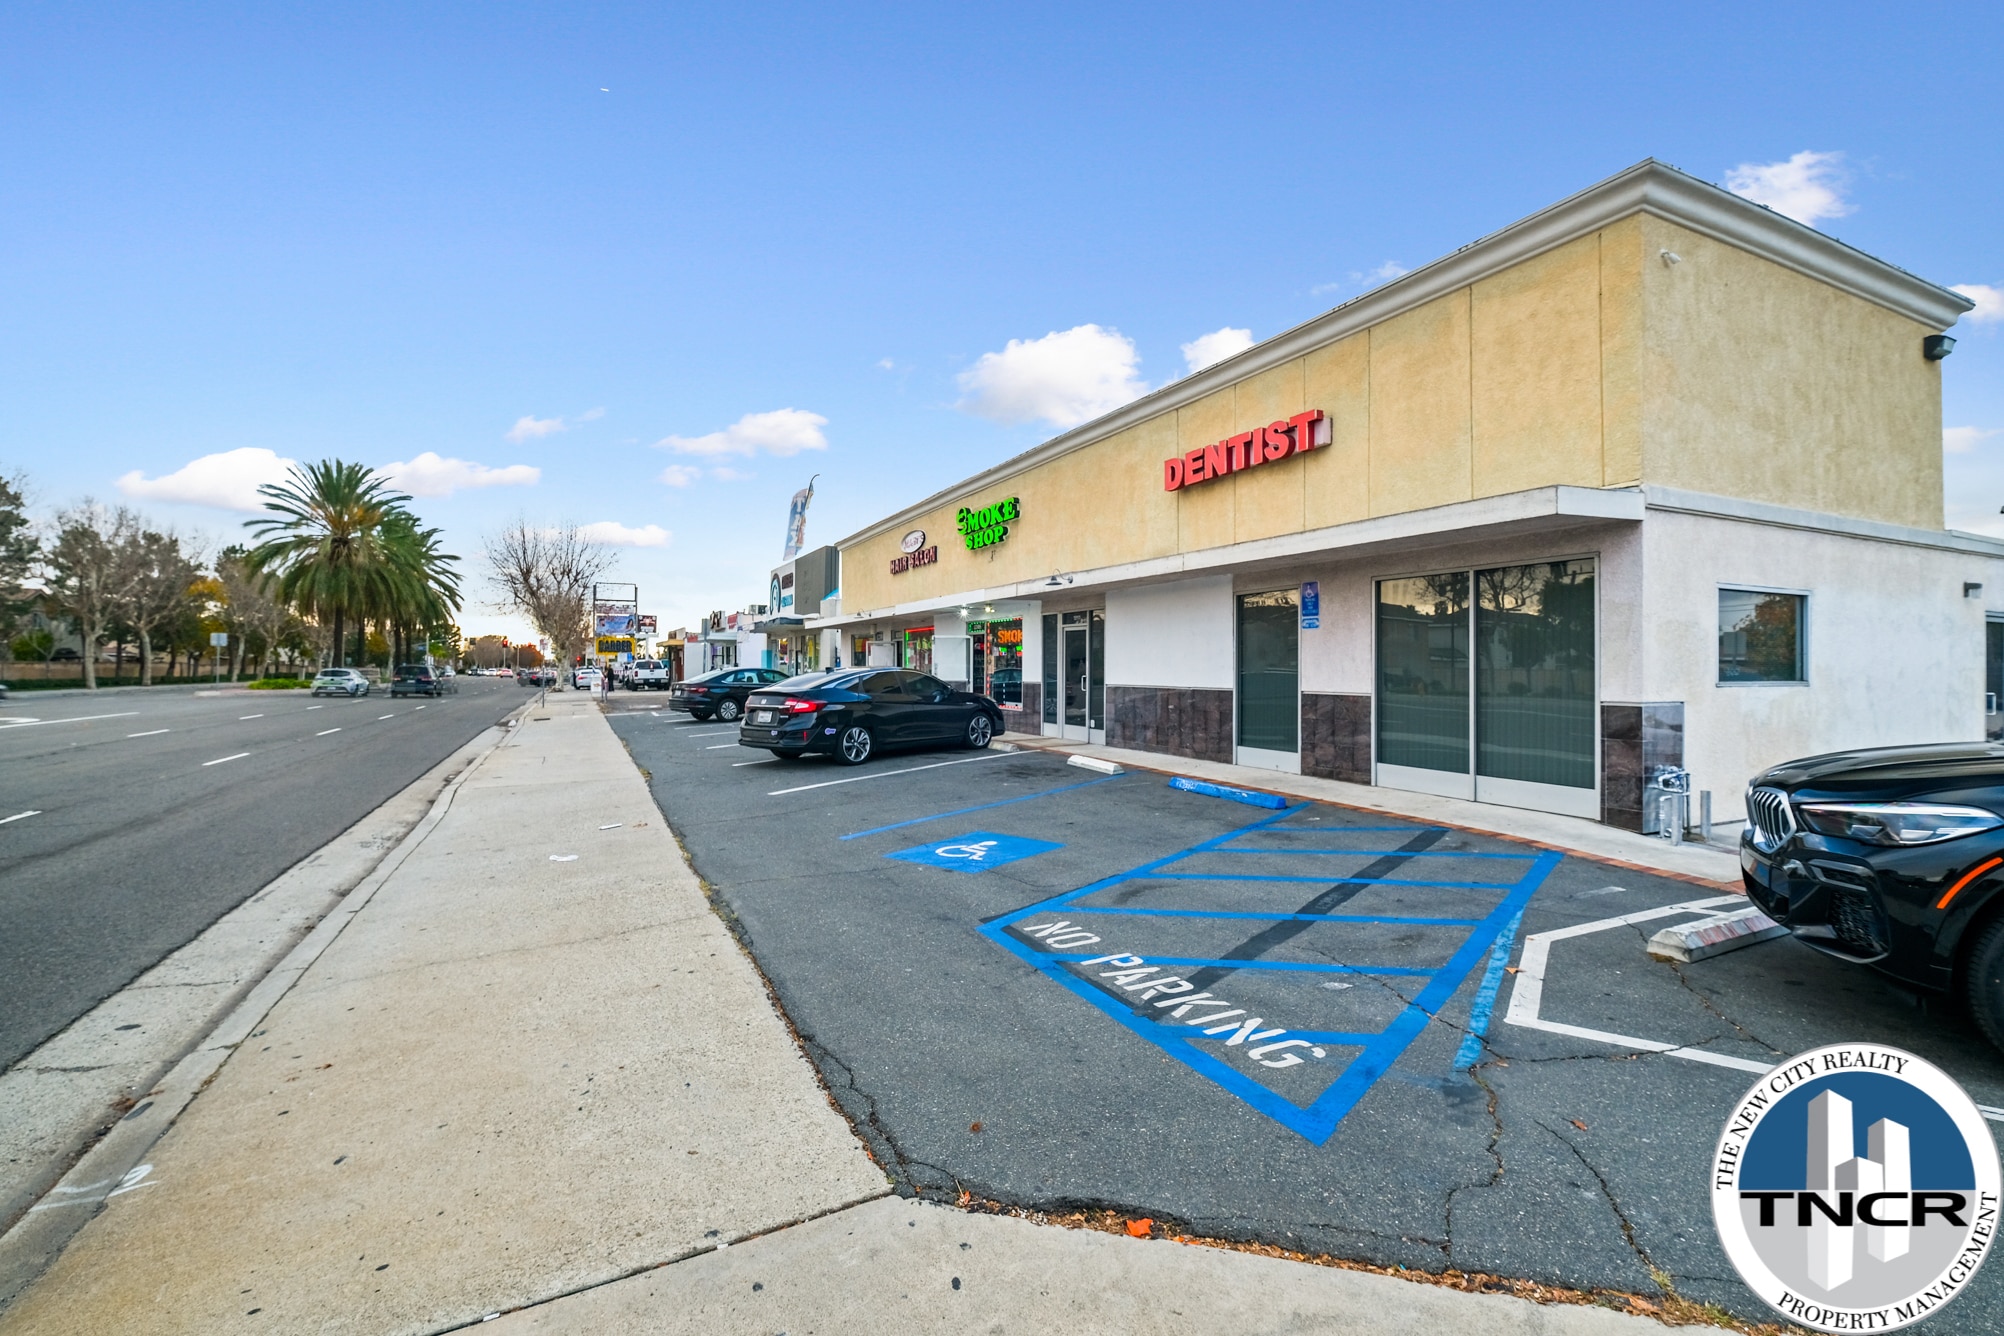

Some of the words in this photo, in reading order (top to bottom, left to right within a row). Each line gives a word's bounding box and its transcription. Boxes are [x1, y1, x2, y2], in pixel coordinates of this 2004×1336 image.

[1164, 409, 1324, 492] DENTIST
[956, 497, 1020, 535] SMOKE
[965, 525, 1009, 550] SHOP
[890, 556, 909, 574] HAIR
[910, 545, 938, 569] SALON
[598, 639, 633, 652] BARBER
[1023, 921, 1101, 949] NO
[1080, 952, 1327, 1068] PARKING
